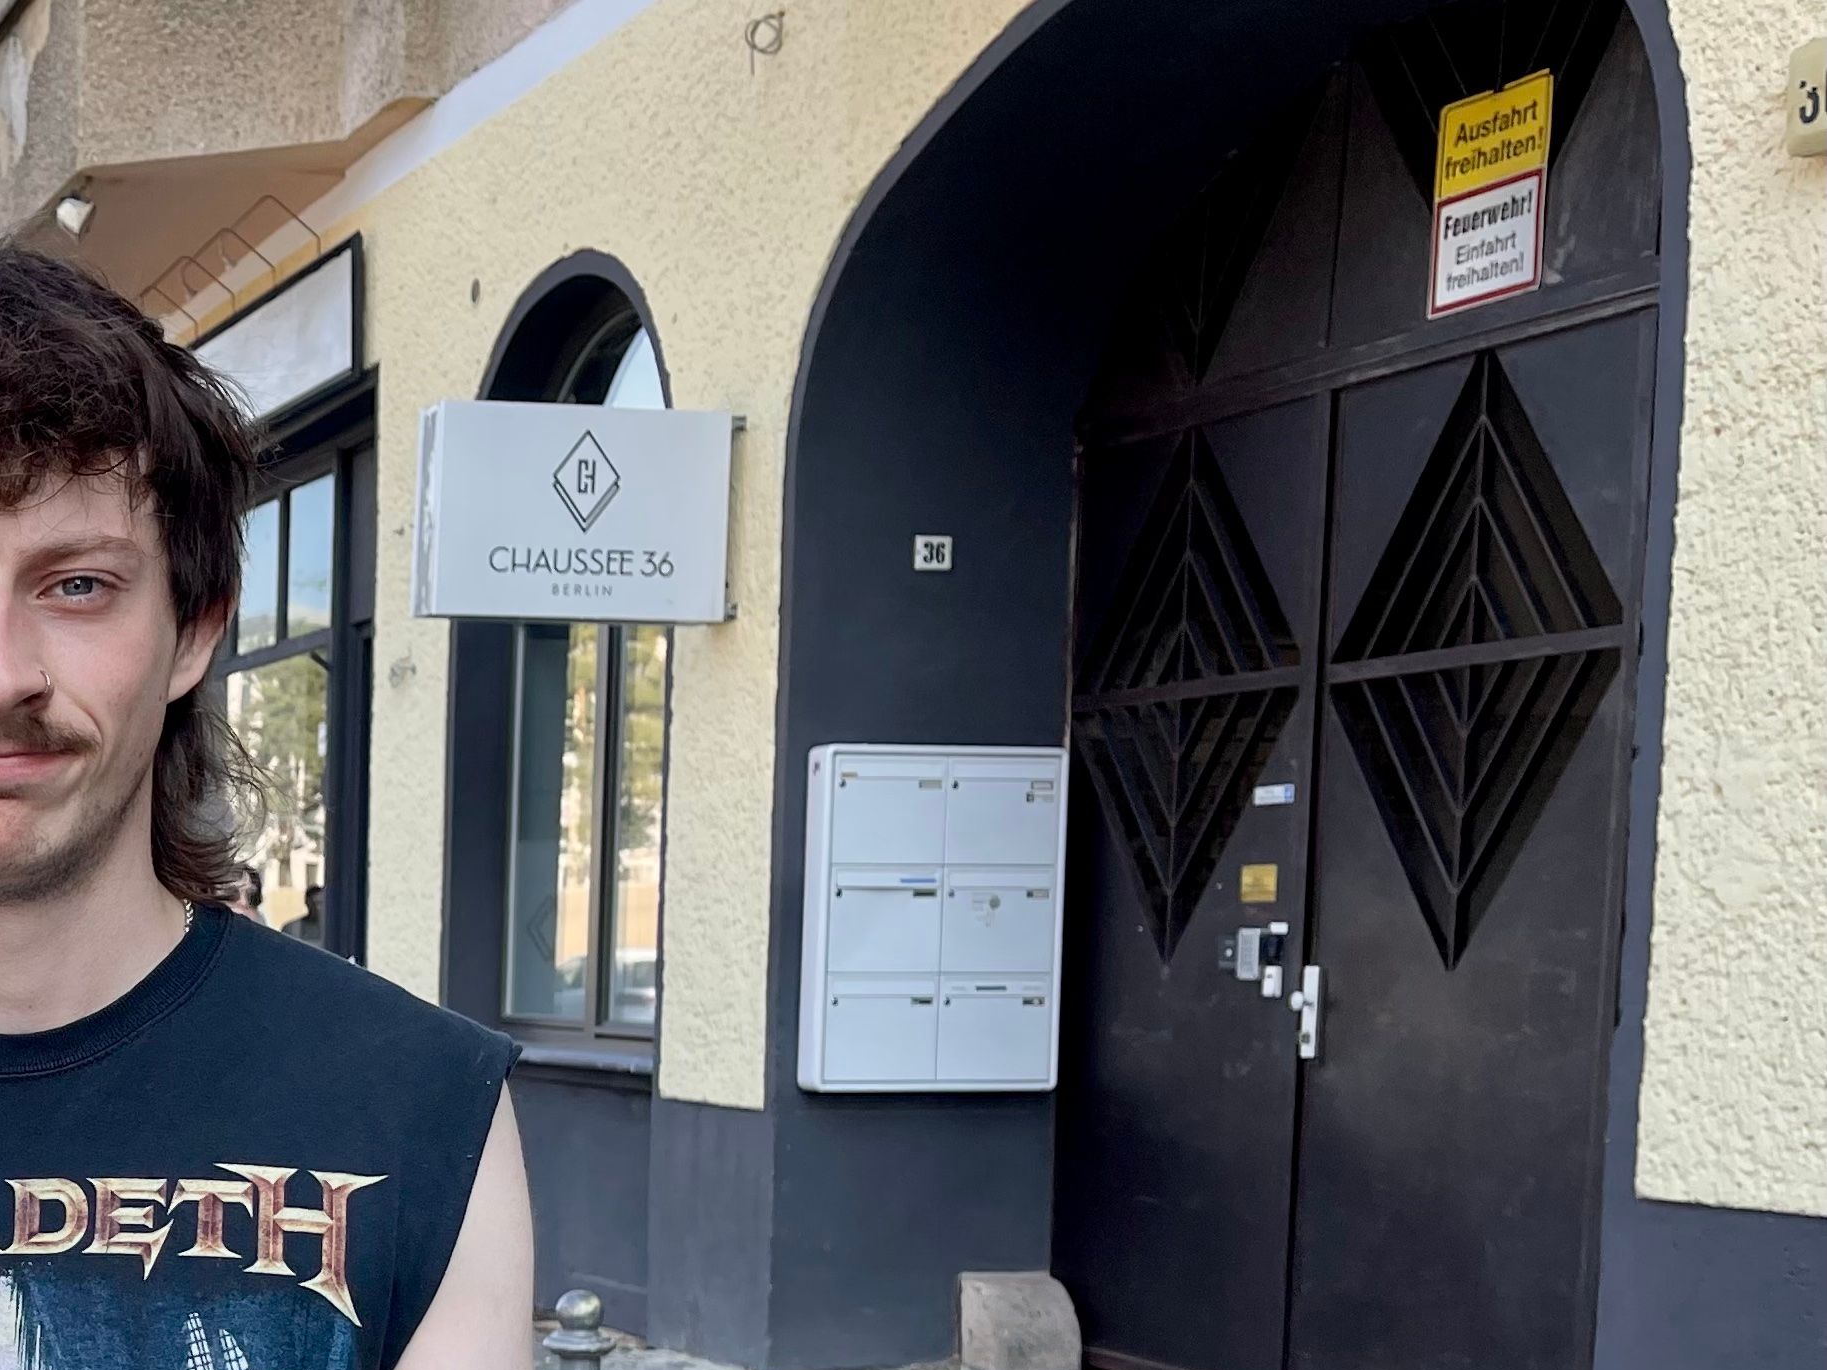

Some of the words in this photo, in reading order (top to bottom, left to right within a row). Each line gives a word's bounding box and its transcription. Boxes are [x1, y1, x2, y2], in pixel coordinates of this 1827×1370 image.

[1454, 100, 1538, 148] Ausfahrt
[1444, 127, 1544, 180] freihalten!
[1443, 190, 1533, 241] Feuerwehr!
[1455, 231, 1517, 266] Einfahrt
[1445, 252, 1525, 292] freihalten!
[488, 546, 634, 576] CHAUSSEE
[640, 551, 675, 578] 36
[923, 541, 946, 564] 36
[551, 583, 613, 597] BERLIN
